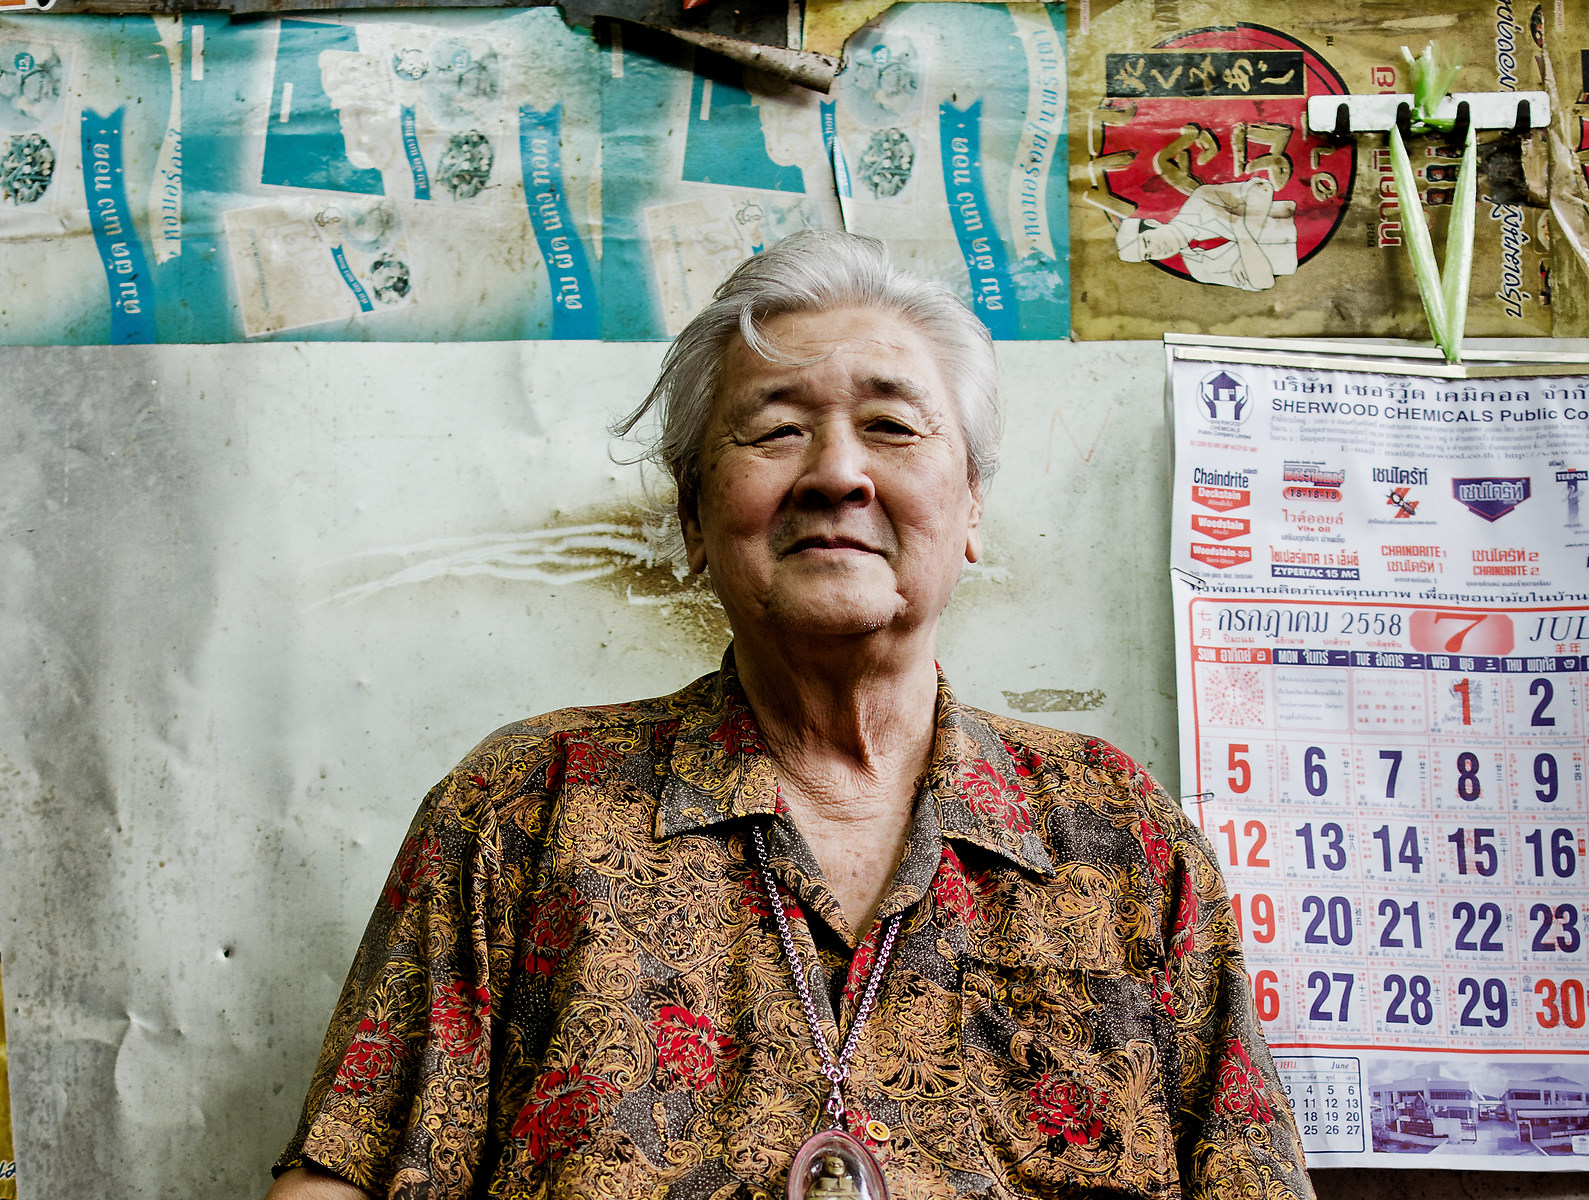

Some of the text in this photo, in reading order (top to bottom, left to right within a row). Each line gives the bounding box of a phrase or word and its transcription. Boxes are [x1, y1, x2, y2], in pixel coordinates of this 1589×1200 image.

[1371, 149, 1401, 247] ทาคมิ
[92, 142, 141, 314] ต้ม ผัด แกง ทอด
[527, 138, 584, 310] ต้ม ผัด แกง ทอด
[950, 136, 1003, 310] ต้ม ผัด แกง ทอด
[1272, 398, 1380, 417] SHERWOOD
[1384, 406, 1493, 423] CHEMICALS
[1500, 408, 1558, 422] Public
[1273, 376, 1333, 395] บริษัท
[1344, 382, 1426, 404] เชอร์วู้ด
[1436, 387, 1531, 403] เคมิคอล
[1194, 467, 1249, 488] Chaindrite
[1198, 487, 1241, 500] Deckstain
[1290, 489, 1337, 500] 18-18-18
[1557, 472, 1587, 480] TEEPOL
[1198, 517, 1244, 530] Woodstain
[1273, 566, 1358, 579] ZYPERTAC 15 MC
[1323, 555, 1335, 566] 15
[1381, 545, 1440, 558] CHAINDRITE
[1473, 565, 1540, 576] CHAINDRITE 2
[1529, 552, 1539, 561] 2
[1197, 609, 1212, 640] 七月
[1218, 608, 1402, 638] กรกฎาคม 2558
[1433, 611, 1489, 653] 7
[1198, 647, 1217, 662] SUN
[1220, 648, 1251, 662] อาทิตย์
[1278, 650, 1298, 663] MON
[1302, 650, 1329, 664] จันทร์
[1355, 653, 1371, 666] TUE
[1375, 652, 1405, 668] อังคาร
[1431, 656, 1450, 669] WED
[1459, 656, 1474, 672] พุธ
[1505, 659, 1522, 672] THU
[1527, 657, 1556, 673] พฤหัส
[1453, 677, 1472, 726] 1
[1529, 677, 1555, 727] 2
[1227, 743, 1251, 794] 5
[1304, 746, 1328, 797] 6
[1379, 750, 1402, 798] 7
[1457, 751, 1481, 802] 8
[1533, 752, 1558, 803] 9
[1218, 819, 1270, 868] 12
[1295, 822, 1347, 871] 13
[1372, 824, 1423, 874] 14
[1448, 827, 1498, 877] 15
[1525, 828, 1576, 878] 16
[1230, 893, 1276, 944] 19
[1302, 895, 1353, 946] 20
[1378, 898, 1422, 949] 21
[1452, 901, 1504, 951] 22
[1529, 903, 1581, 953] 23
[1248, 970, 1280, 1022] 6
[1307, 970, 1354, 1022] 27
[1383, 973, 1433, 1026] 28
[1458, 977, 1509, 1028] 29
[1534, 978, 1586, 1029] 30
[1284, 1085, 1355, 1095] 3 4 5 6
[1330, 1061, 1349, 1070] June
[1303, 1098, 1359, 1109] 11 12 13
[1303, 1112, 1360, 1122] 18 19 20
[1303, 1125, 1361, 1135] 25 26 27
